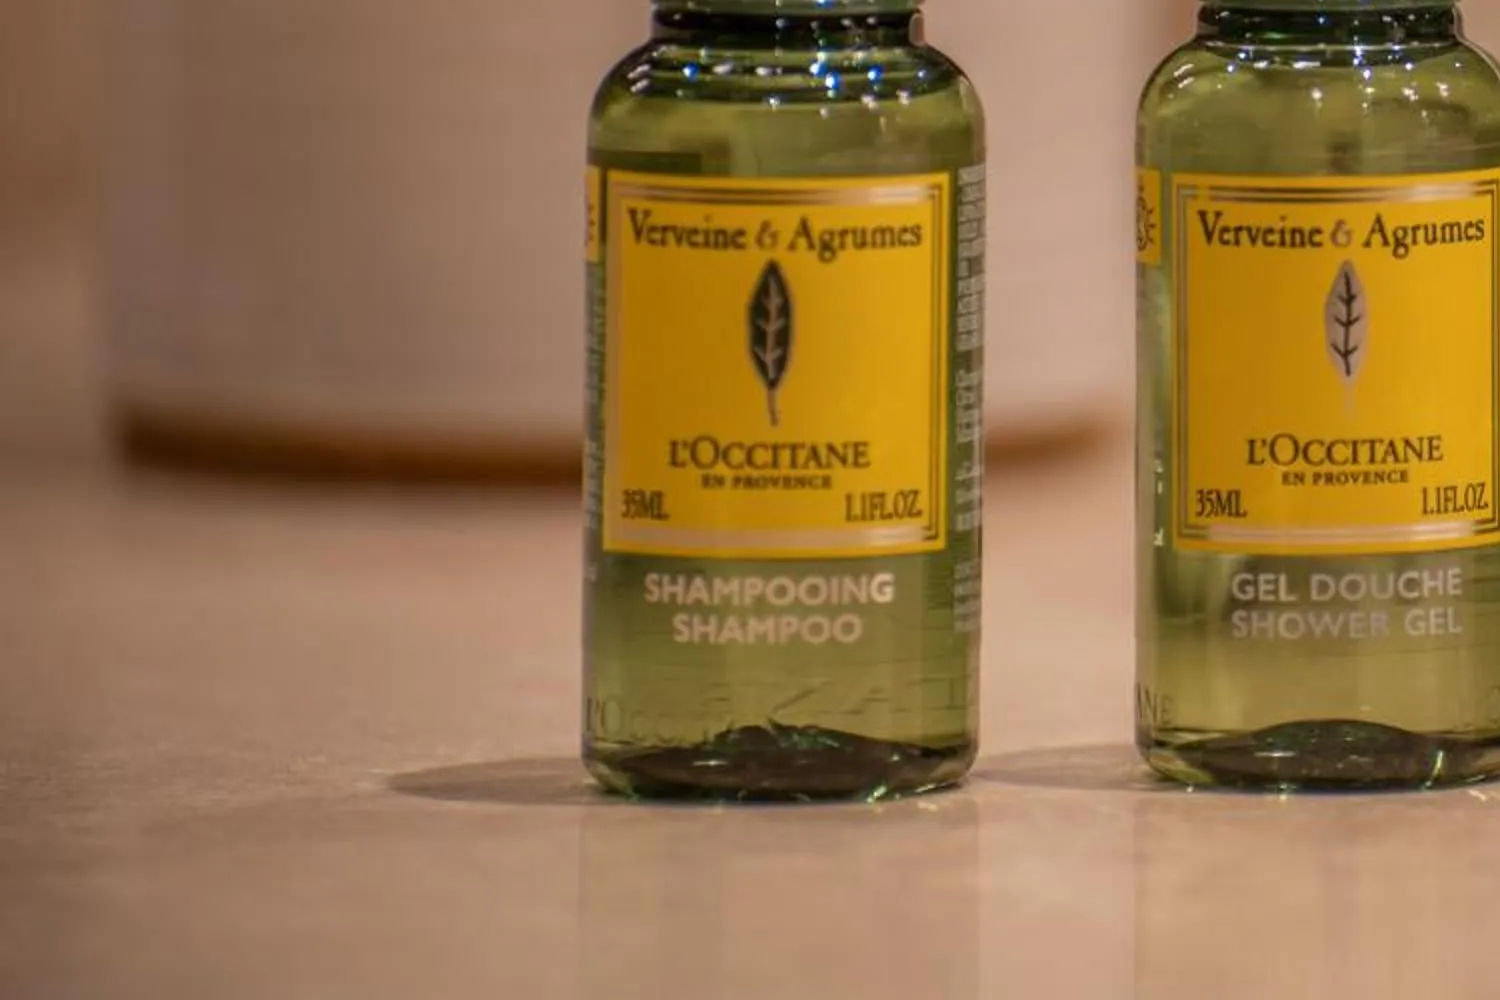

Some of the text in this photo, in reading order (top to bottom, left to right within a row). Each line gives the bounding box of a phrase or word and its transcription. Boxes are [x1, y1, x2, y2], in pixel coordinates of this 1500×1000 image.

[627, 208, 922, 263] Verveine & Agrumes
[1198, 211, 1485, 260] Verveine & Agrumes
[702, 474, 832, 490] EN PROVENCE
[1281, 470, 1409, 486] EN PROVENCE
[644, 572, 895, 606] SHAMPOOING
[1232, 568, 1463, 602] GEL DOUCHE
[672, 614, 863, 645] SHAMPOO
[1231, 607, 1463, 640] SHOWER GEL
